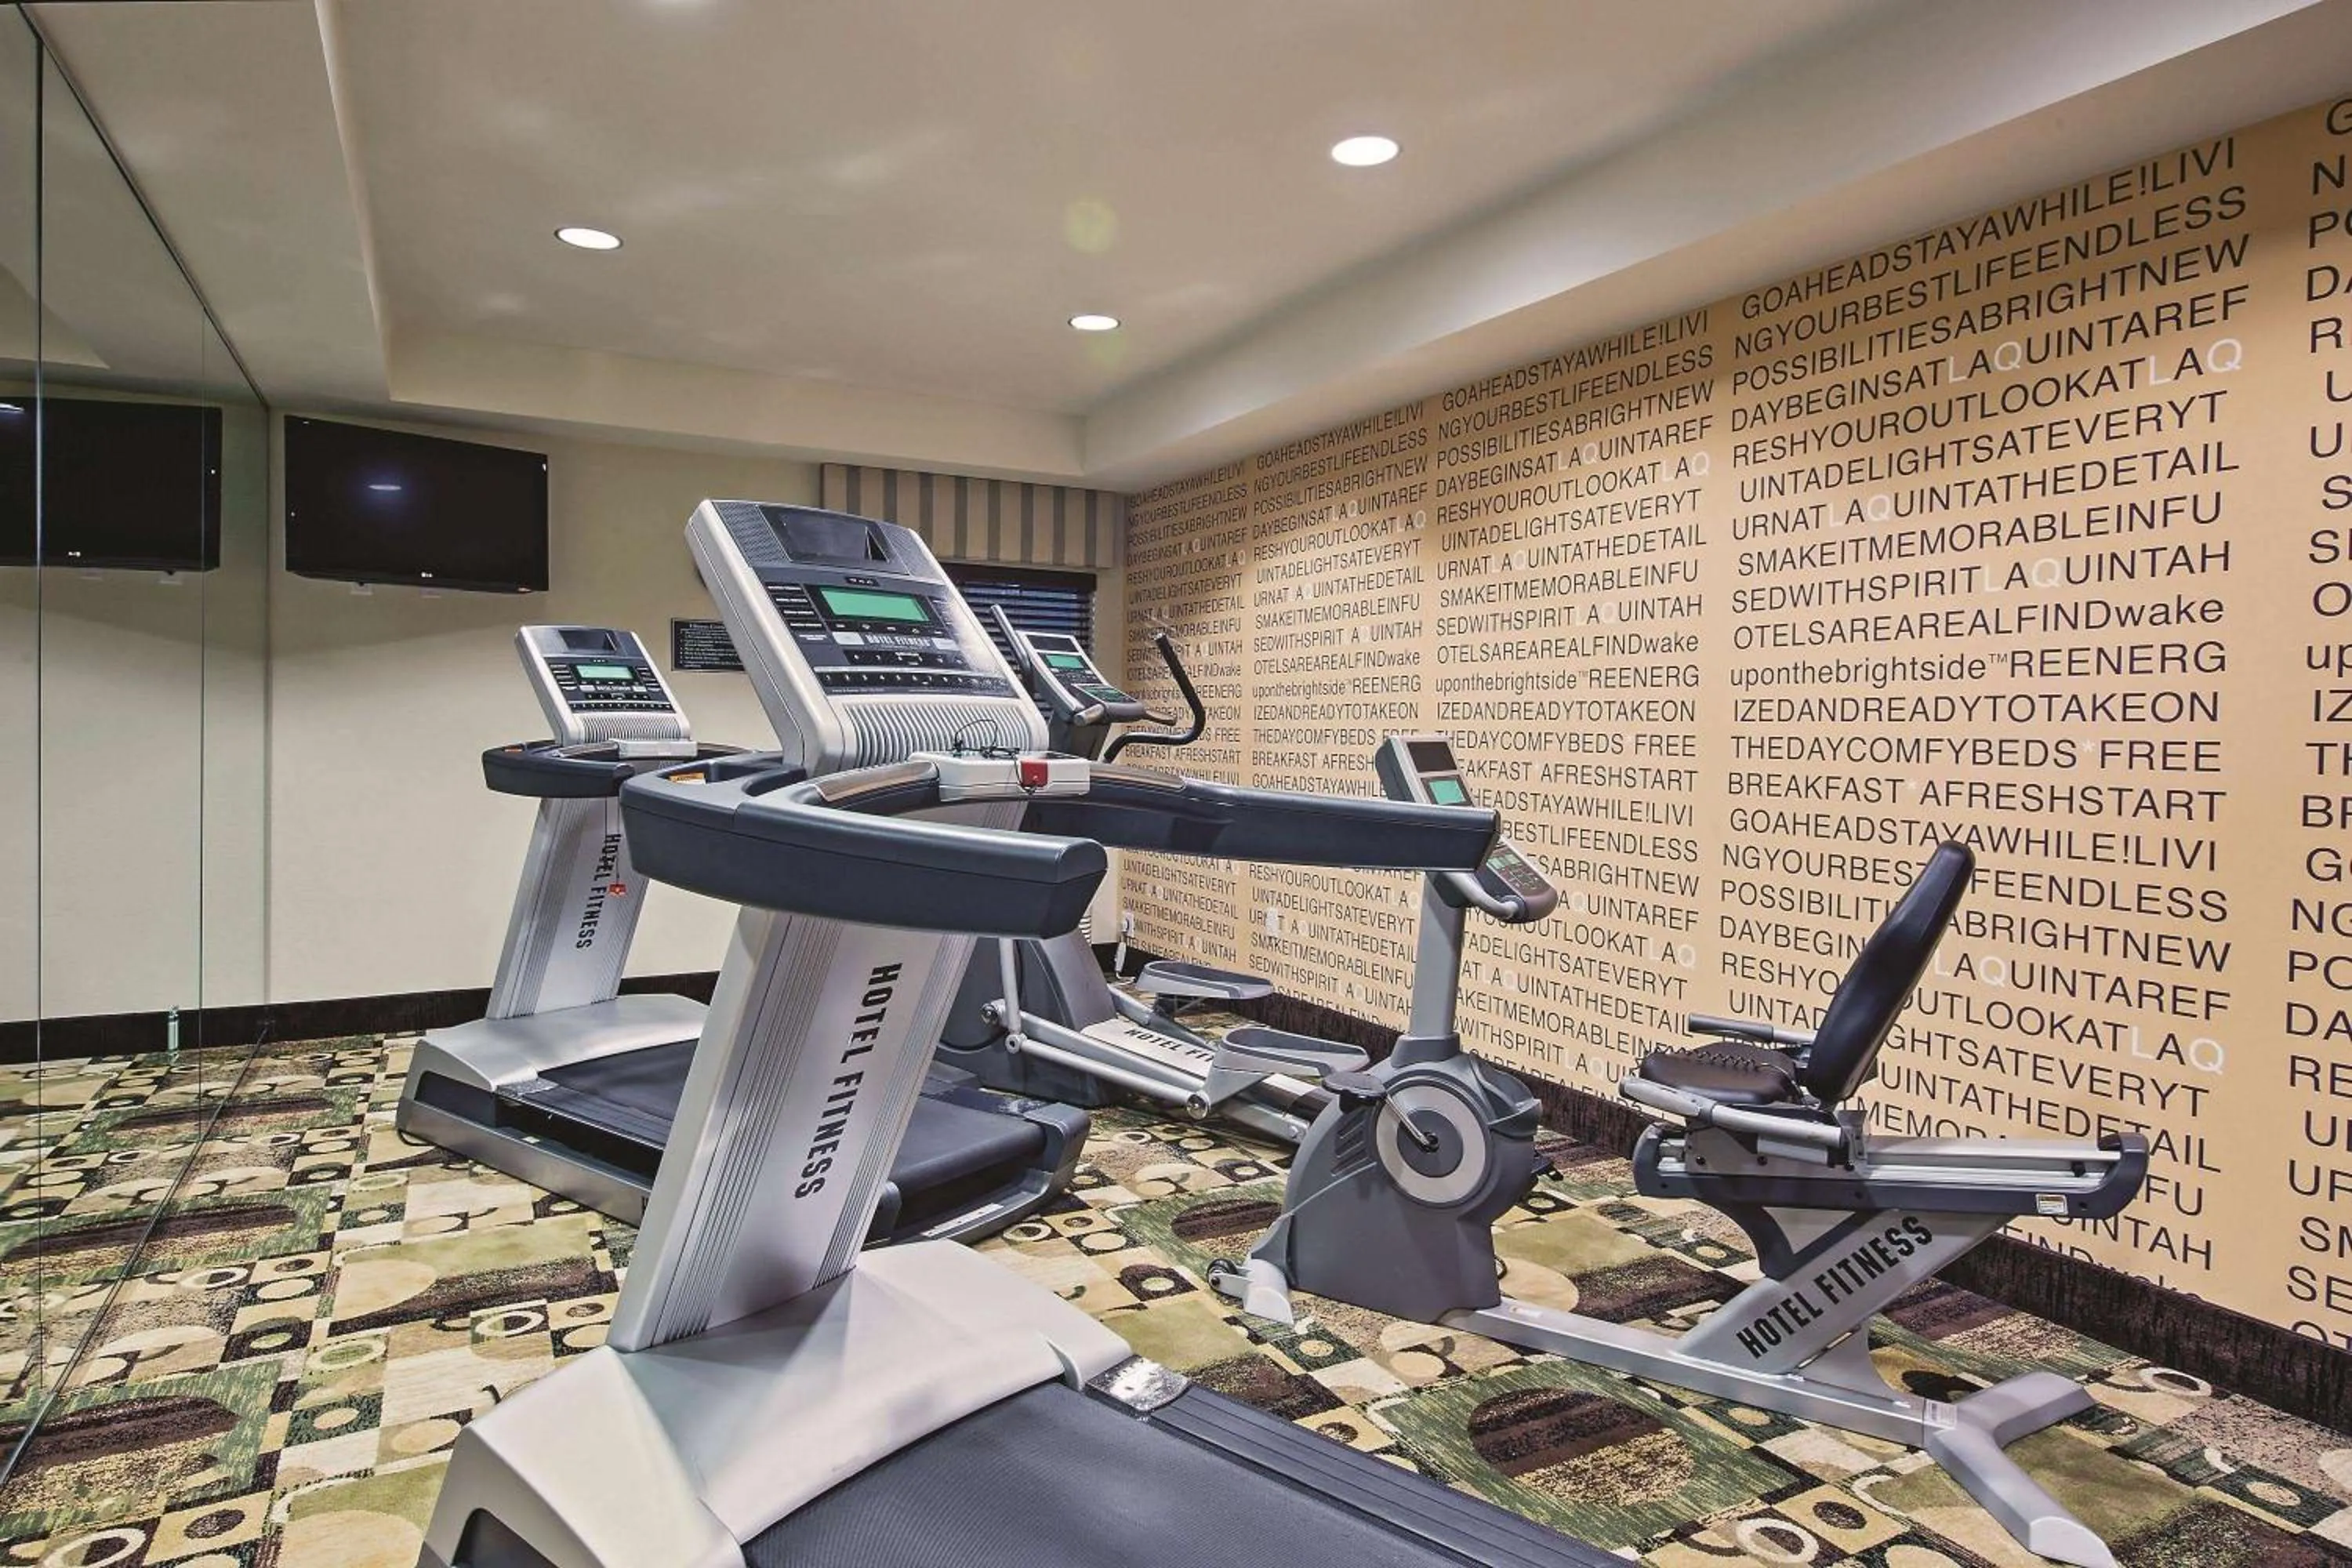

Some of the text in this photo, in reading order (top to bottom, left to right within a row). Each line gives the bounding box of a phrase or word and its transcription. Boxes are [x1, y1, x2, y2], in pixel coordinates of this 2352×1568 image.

[1436, 729, 1625, 753] HEDAYCOMFYBEDS
[576, 833, 621, 950] HOTEL FITNESS
[794, 963, 903, 1199] HOTEL FITNESS
[1124, 1029, 1182, 1052] HOTEL
[1735, 1292, 1824, 1359] HOTEL
[1813, 1216, 1933, 1305] FITNESS
